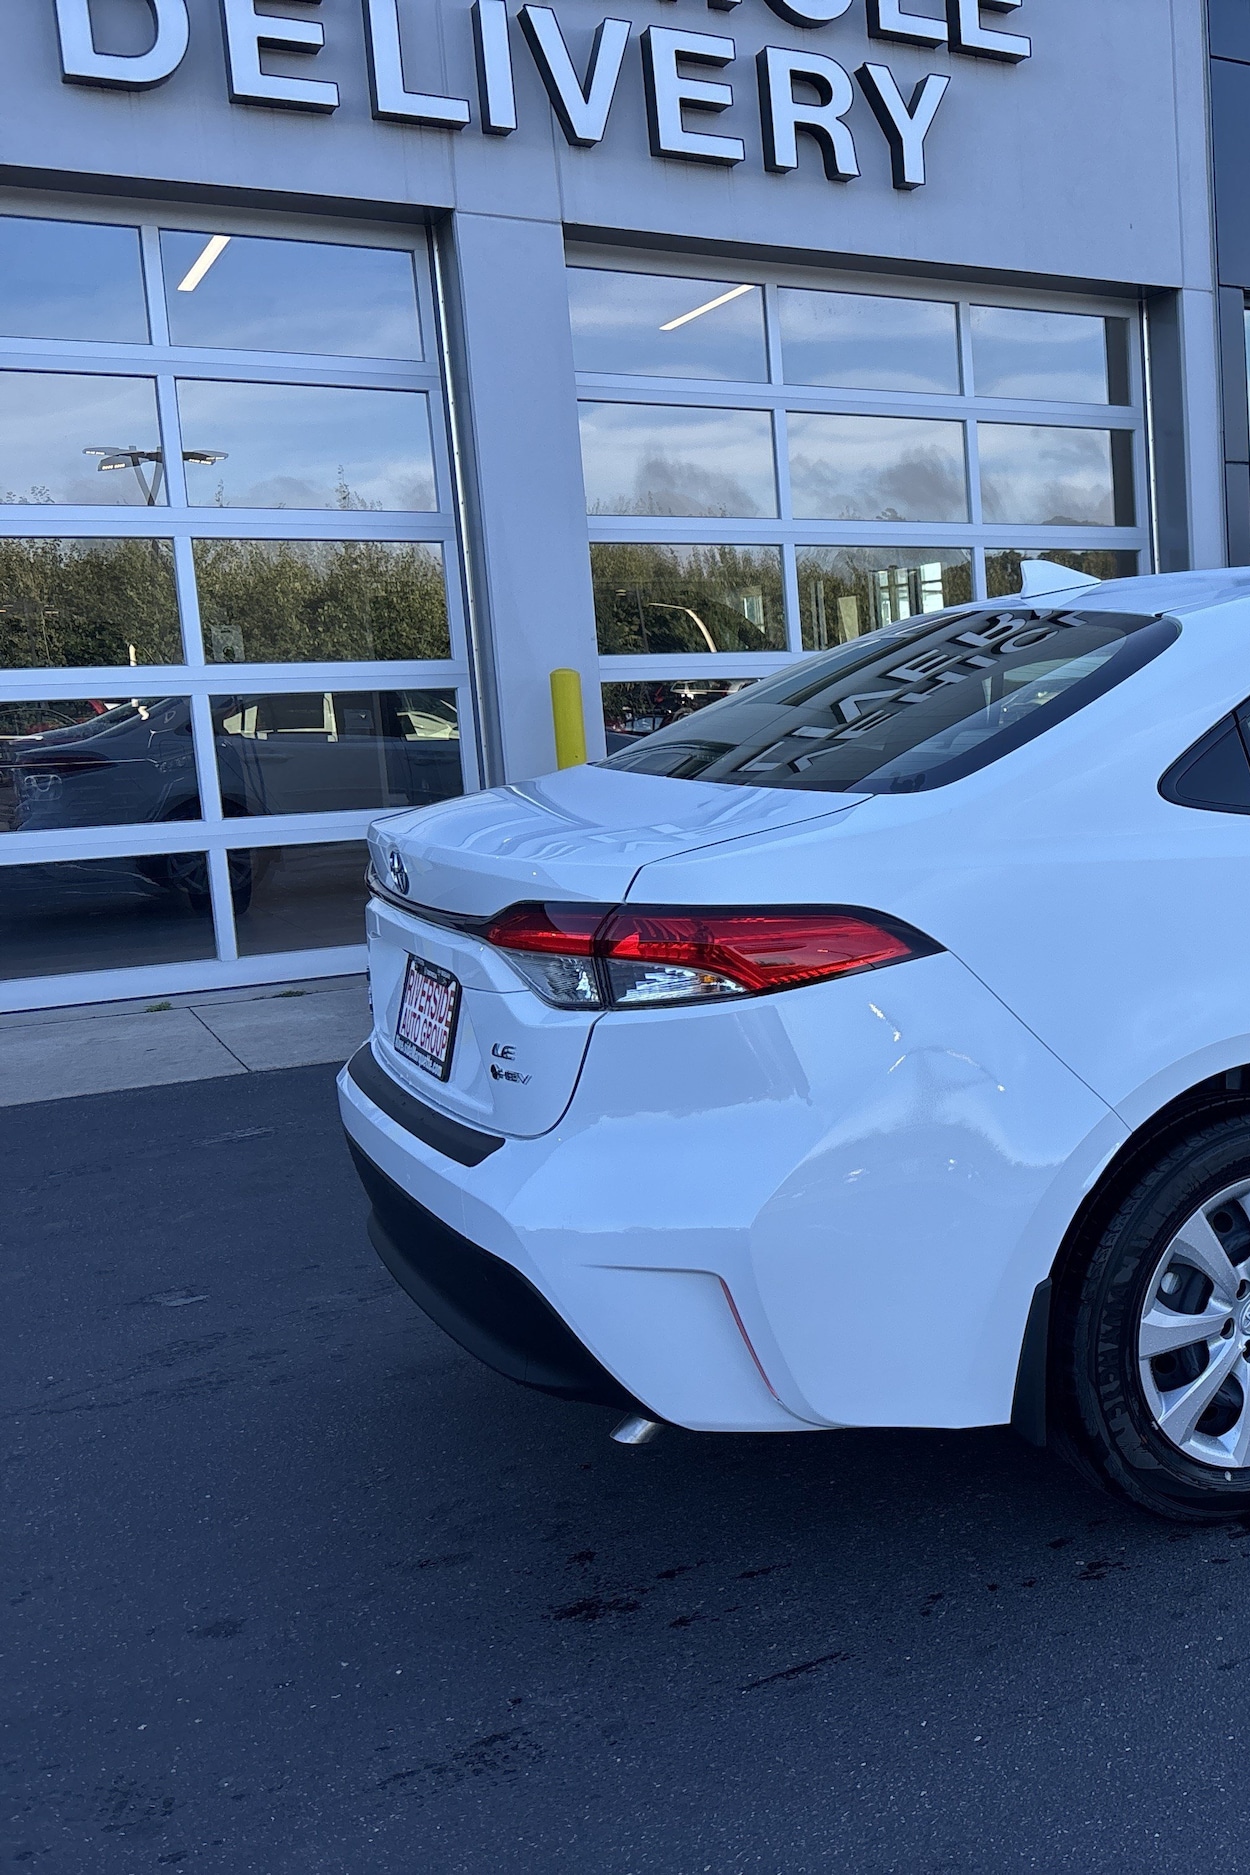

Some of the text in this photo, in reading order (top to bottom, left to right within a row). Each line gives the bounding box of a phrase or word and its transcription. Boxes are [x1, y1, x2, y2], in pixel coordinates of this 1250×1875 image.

[55, 0, 950, 190] DELIVERY
[404, 969, 455, 1028] RIVERSIDE
[401, 1007, 421, 1043] AUTO
[420, 1018, 448, 1058] GROUP
